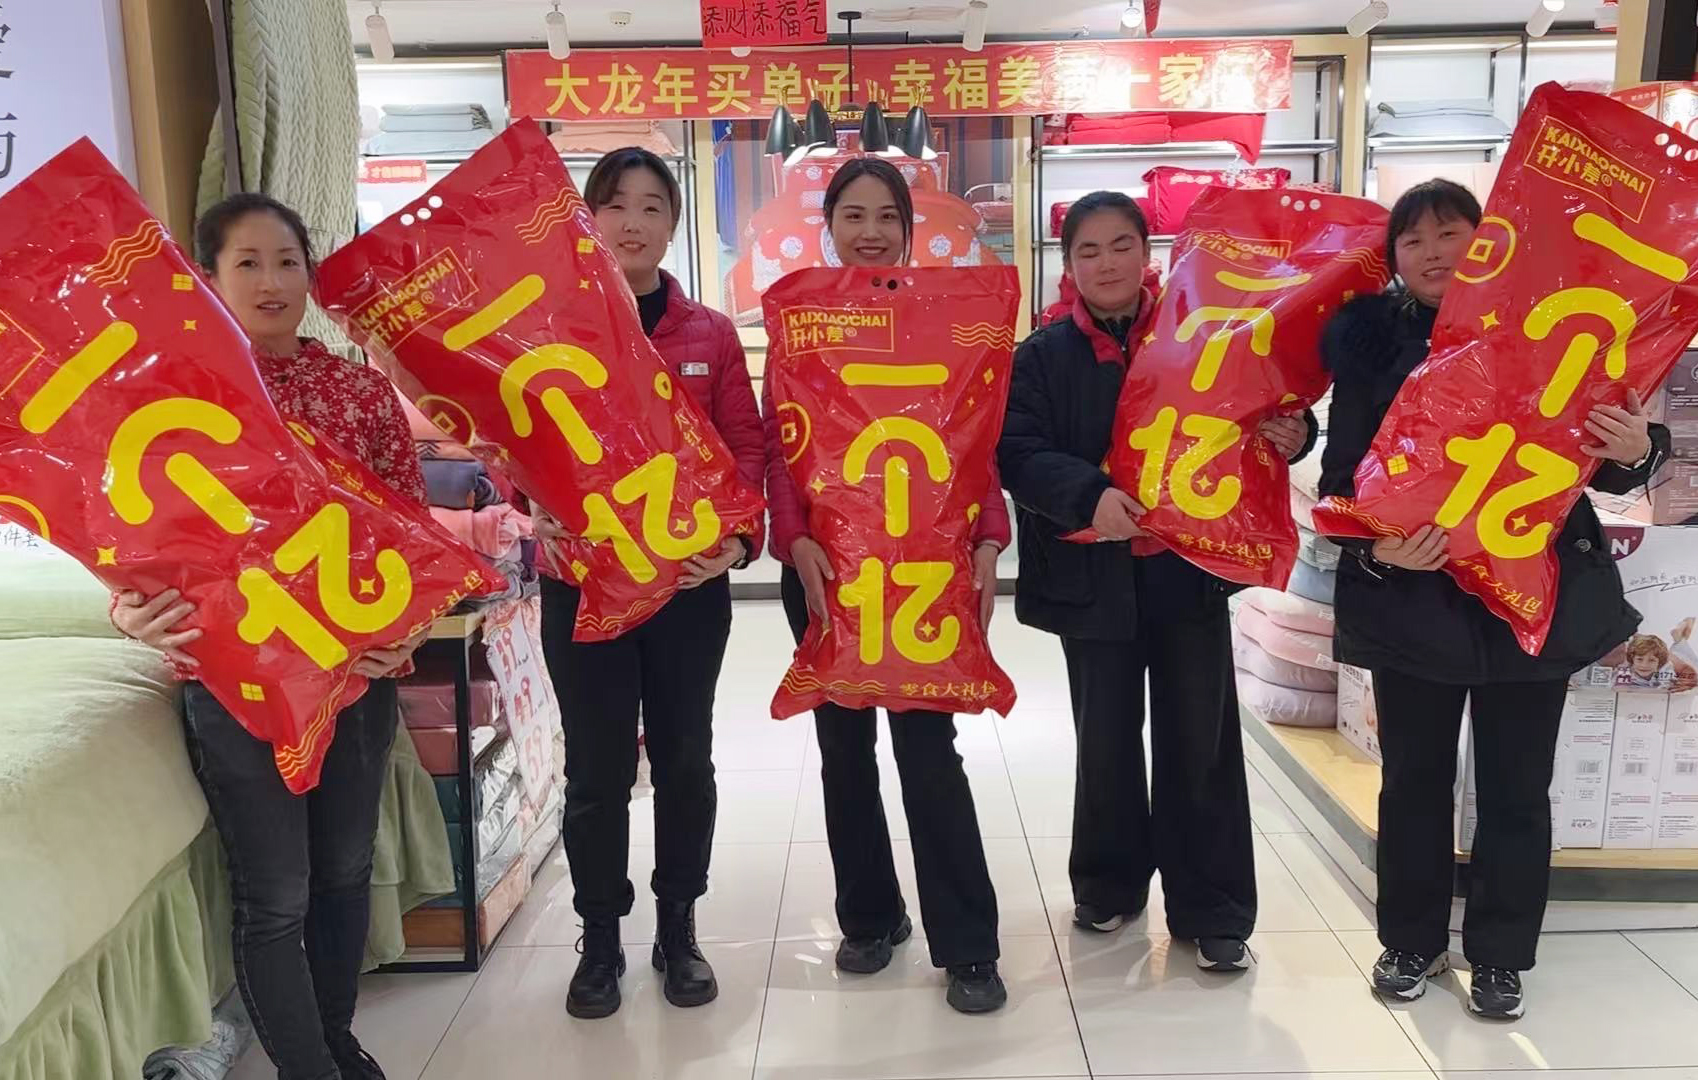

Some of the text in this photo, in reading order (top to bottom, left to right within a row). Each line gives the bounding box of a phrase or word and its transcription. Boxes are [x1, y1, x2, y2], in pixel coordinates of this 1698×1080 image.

[703, 0, 828, 38] 添财添福气
[544, 63, 859, 115] 大龙年买单子
[1545, 126, 1645, 194] KAIXIAOCHAI
[788, 311, 887, 329] KAIXIAOCHAI
[1128, 270, 1311, 520] 一个亿
[1435, 212, 1689, 559] 一个亿
[443, 274, 721, 584] 一个亿
[20, 321, 413, 671] 一个亿
[838, 363, 961, 665] 一个亿
[1175, 532, 1274, 560] 零食大礼包
[899, 680, 998, 697] 零食大礼包
